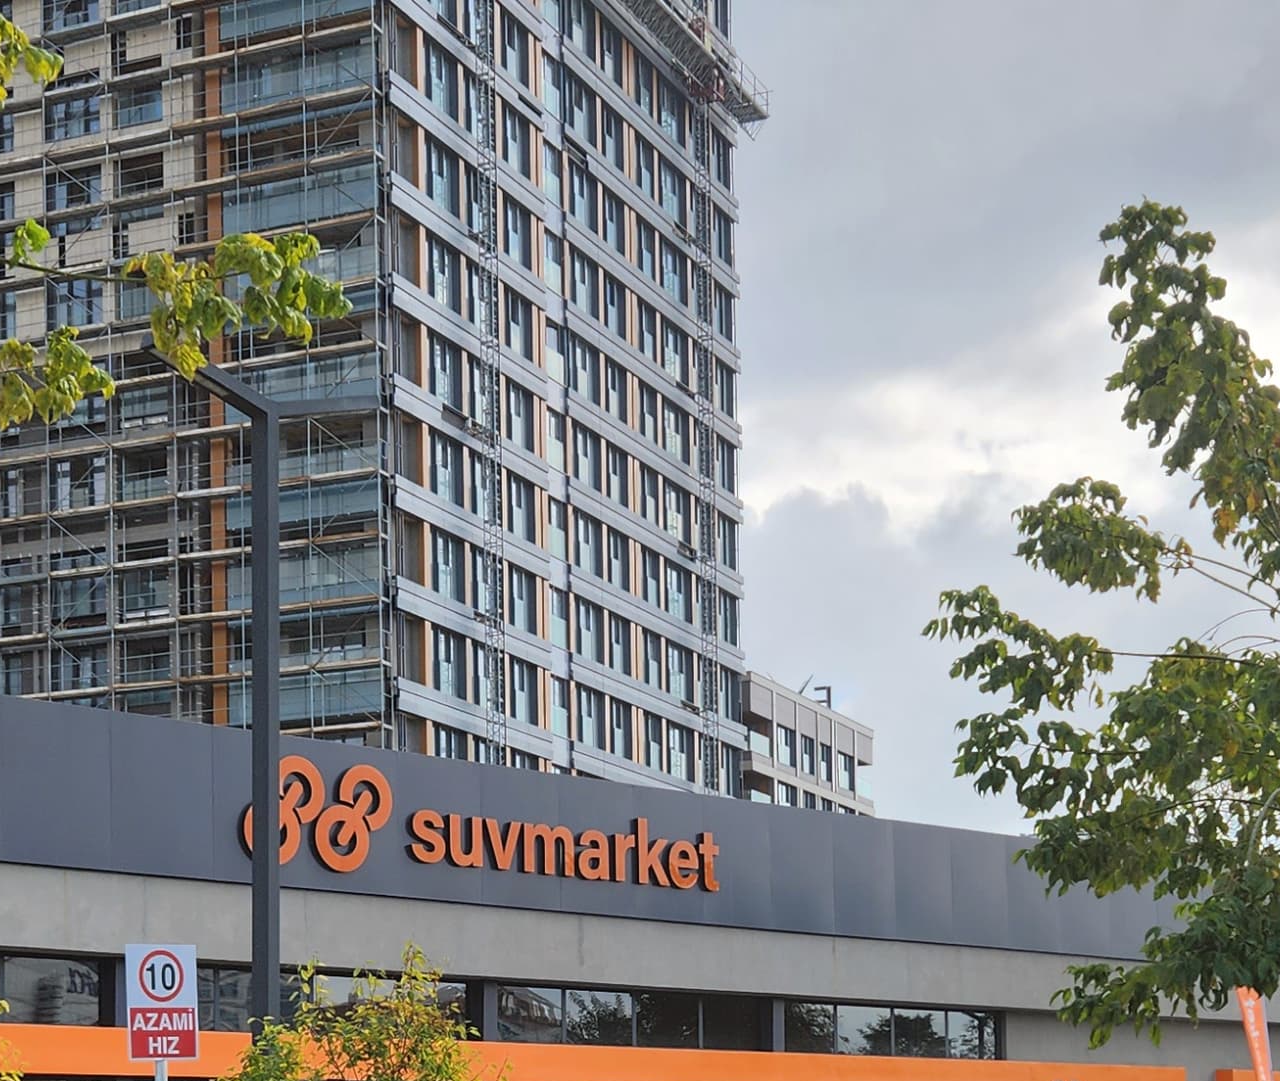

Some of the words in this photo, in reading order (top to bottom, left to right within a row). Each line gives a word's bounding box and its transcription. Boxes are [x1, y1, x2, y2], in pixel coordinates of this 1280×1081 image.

[407, 808, 720, 892] suvmarket
[146, 963, 176, 991] 10
[132, 1008, 194, 1031] AZAMİ
[148, 1036, 180, 1055] HIZ
